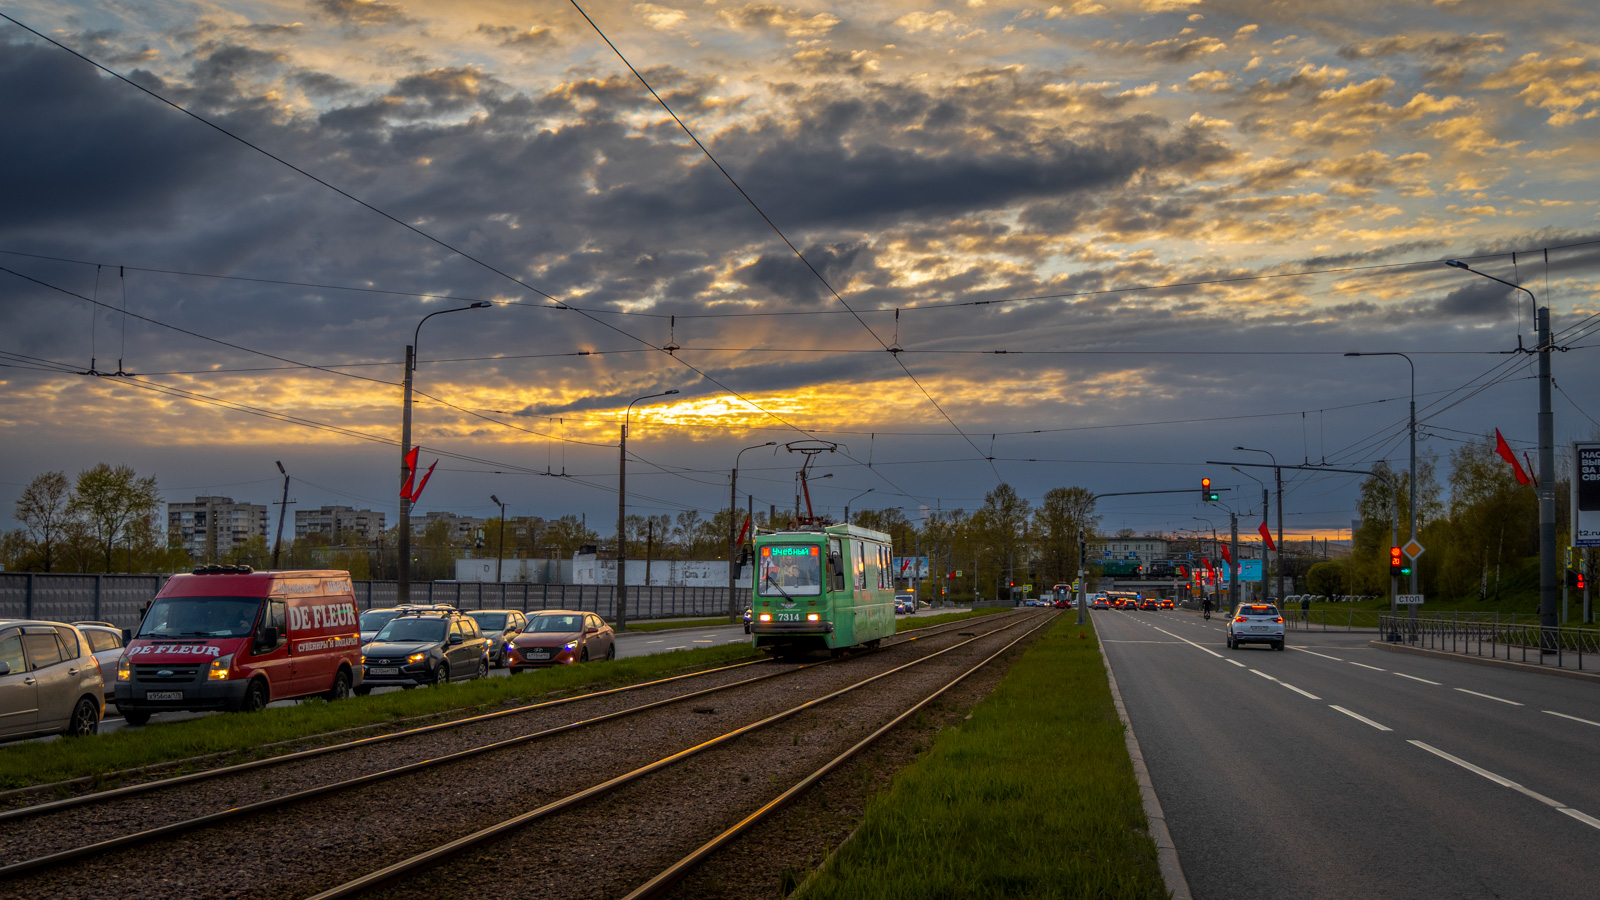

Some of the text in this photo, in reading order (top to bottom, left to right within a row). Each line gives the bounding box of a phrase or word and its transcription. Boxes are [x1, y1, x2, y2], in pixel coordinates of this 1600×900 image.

[1582, 466, 1596, 474] ЗА
[772, 547, 809, 556] Учебный
[288, 603, 357, 631] DE FLEUR
[778, 613, 800, 621] 7314
[298, 640, 329, 652] СУВЕНИРЫ
[335, 637, 358, 647] ПОДАРКИ
[128, 644, 221, 657] DE FLEUR
